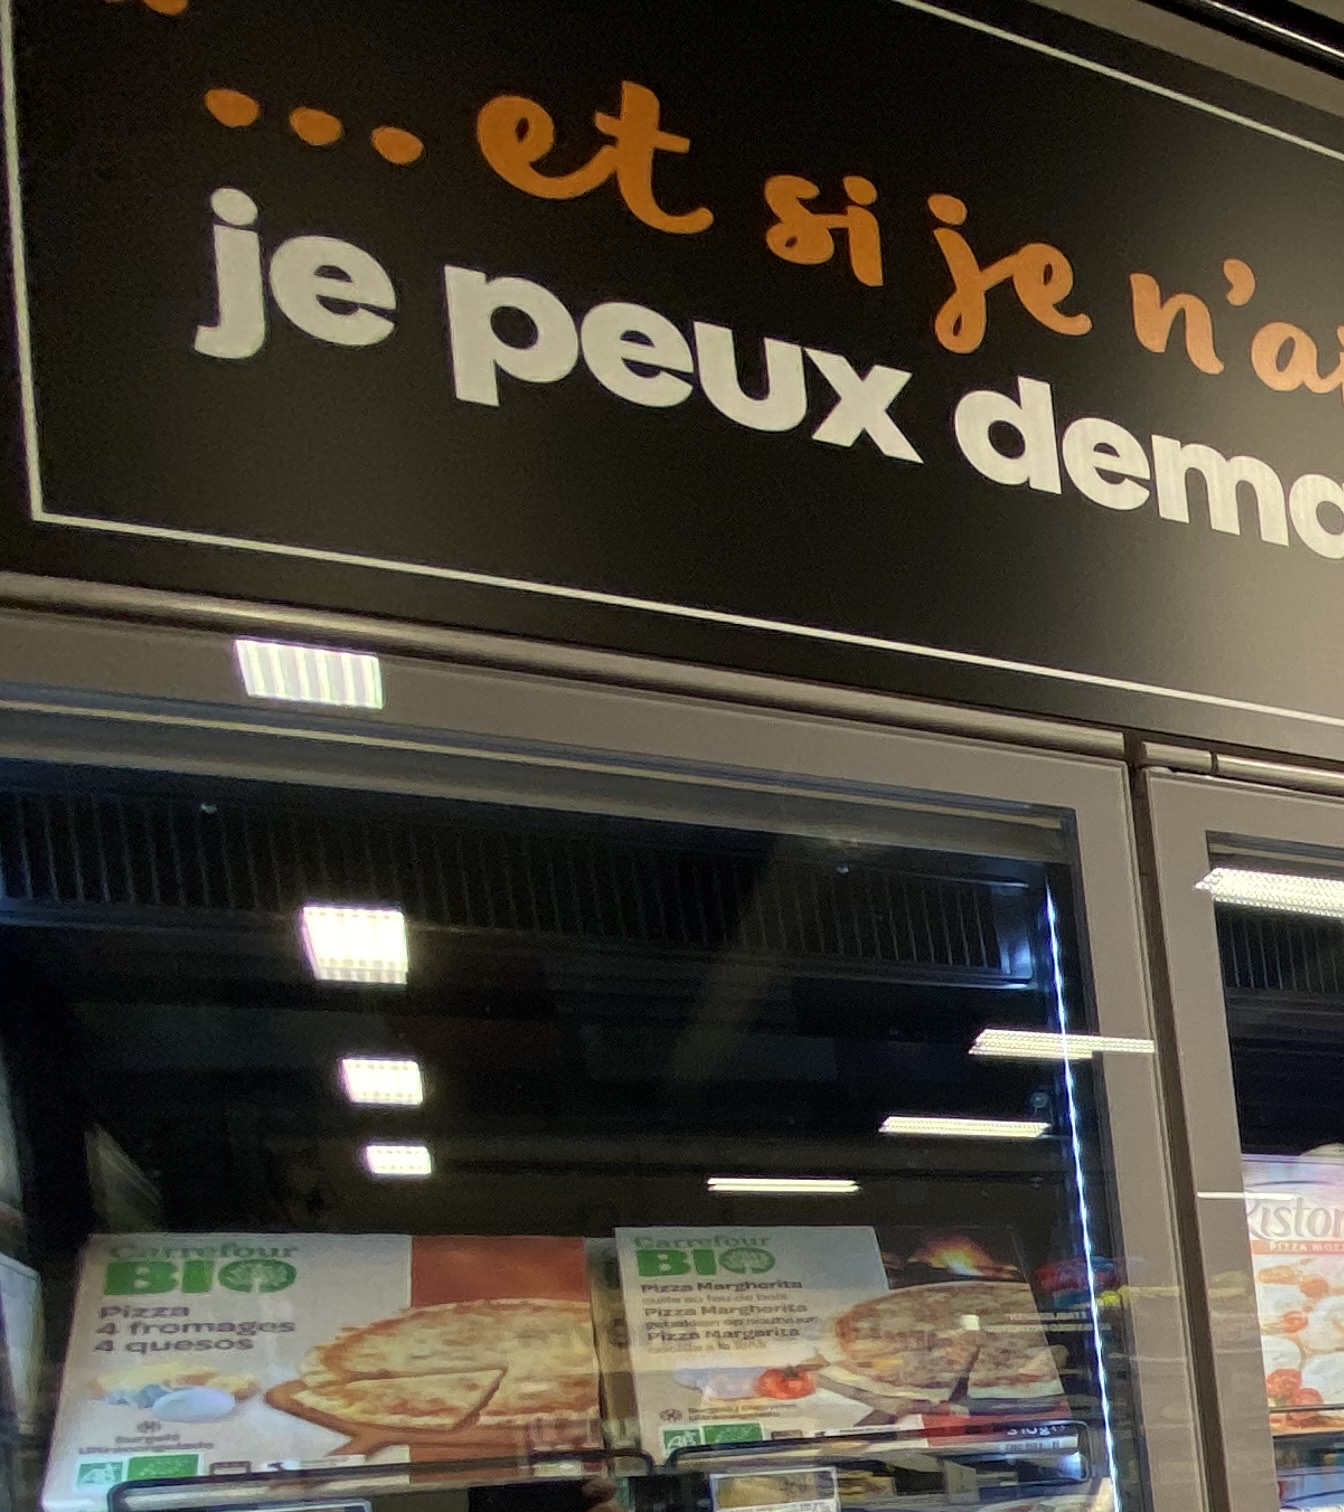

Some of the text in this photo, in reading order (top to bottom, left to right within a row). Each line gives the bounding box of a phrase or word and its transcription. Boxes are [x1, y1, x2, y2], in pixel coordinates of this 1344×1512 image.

[763, 174, 884, 287] si
[927, 193, 1092, 354] je
[194, 187, 397, 360] je
[443, 264, 923, 465] peux
[1269, 1240, 1306, 1252] PIZZA
[635, 1247, 777, 1277] BIO
[103, 1258, 298, 1296] BIO
[640, 1279, 803, 1293] Pizza Margherita
[99, 1304, 191, 1320] Pizza
[643, 1303, 809, 1317] Pizza Margherita
[95, 1320, 297, 1337] 4 fromages
[647, 1330, 700, 1342] Pizza
[94, 1338, 255, 1355] 4 quesos
